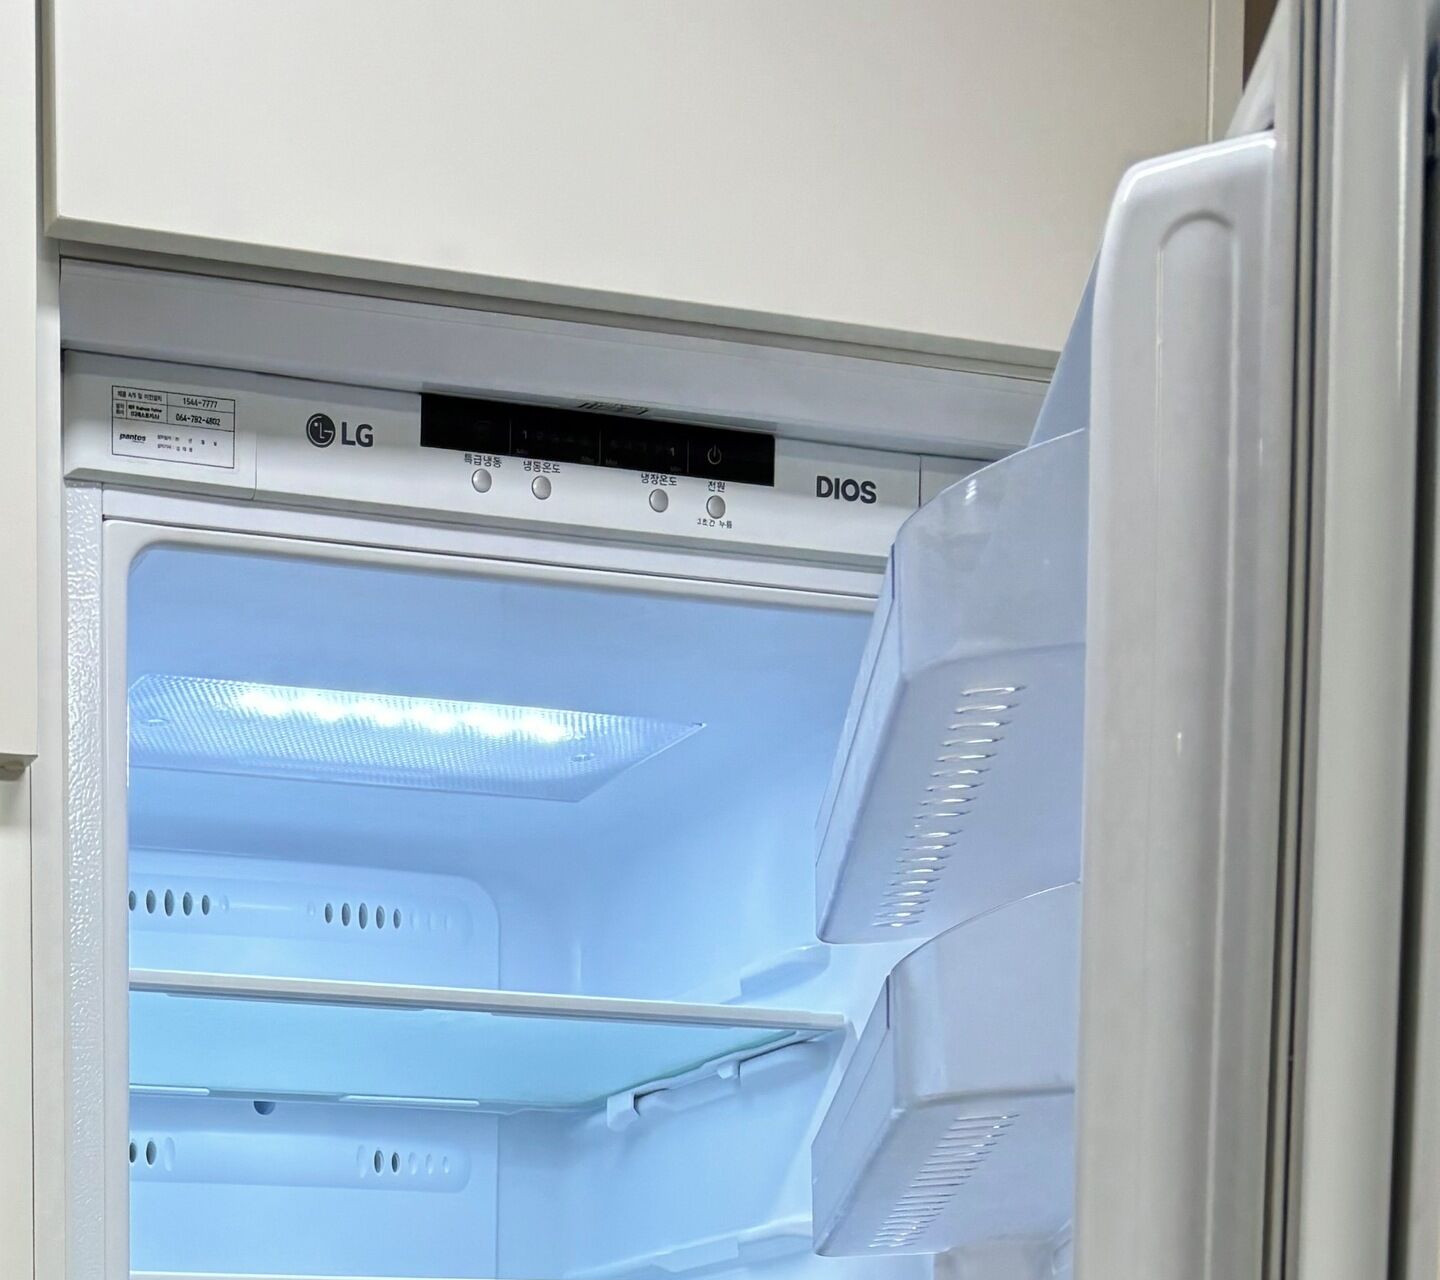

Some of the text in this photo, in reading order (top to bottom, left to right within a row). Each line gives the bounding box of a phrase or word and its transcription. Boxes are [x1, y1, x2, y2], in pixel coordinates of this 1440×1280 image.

[183, 397, 218, 408] 1544-7777
[119, 432, 146, 443] pantos
[341, 421, 374, 448] LG
[464, 453, 502, 468] 특급냉동
[523, 460, 561, 474] 냉동온도
[640, 472, 678, 486] 냉장온도
[708, 481, 726, 494] 전원
[816, 475, 877, 504] DIOS
